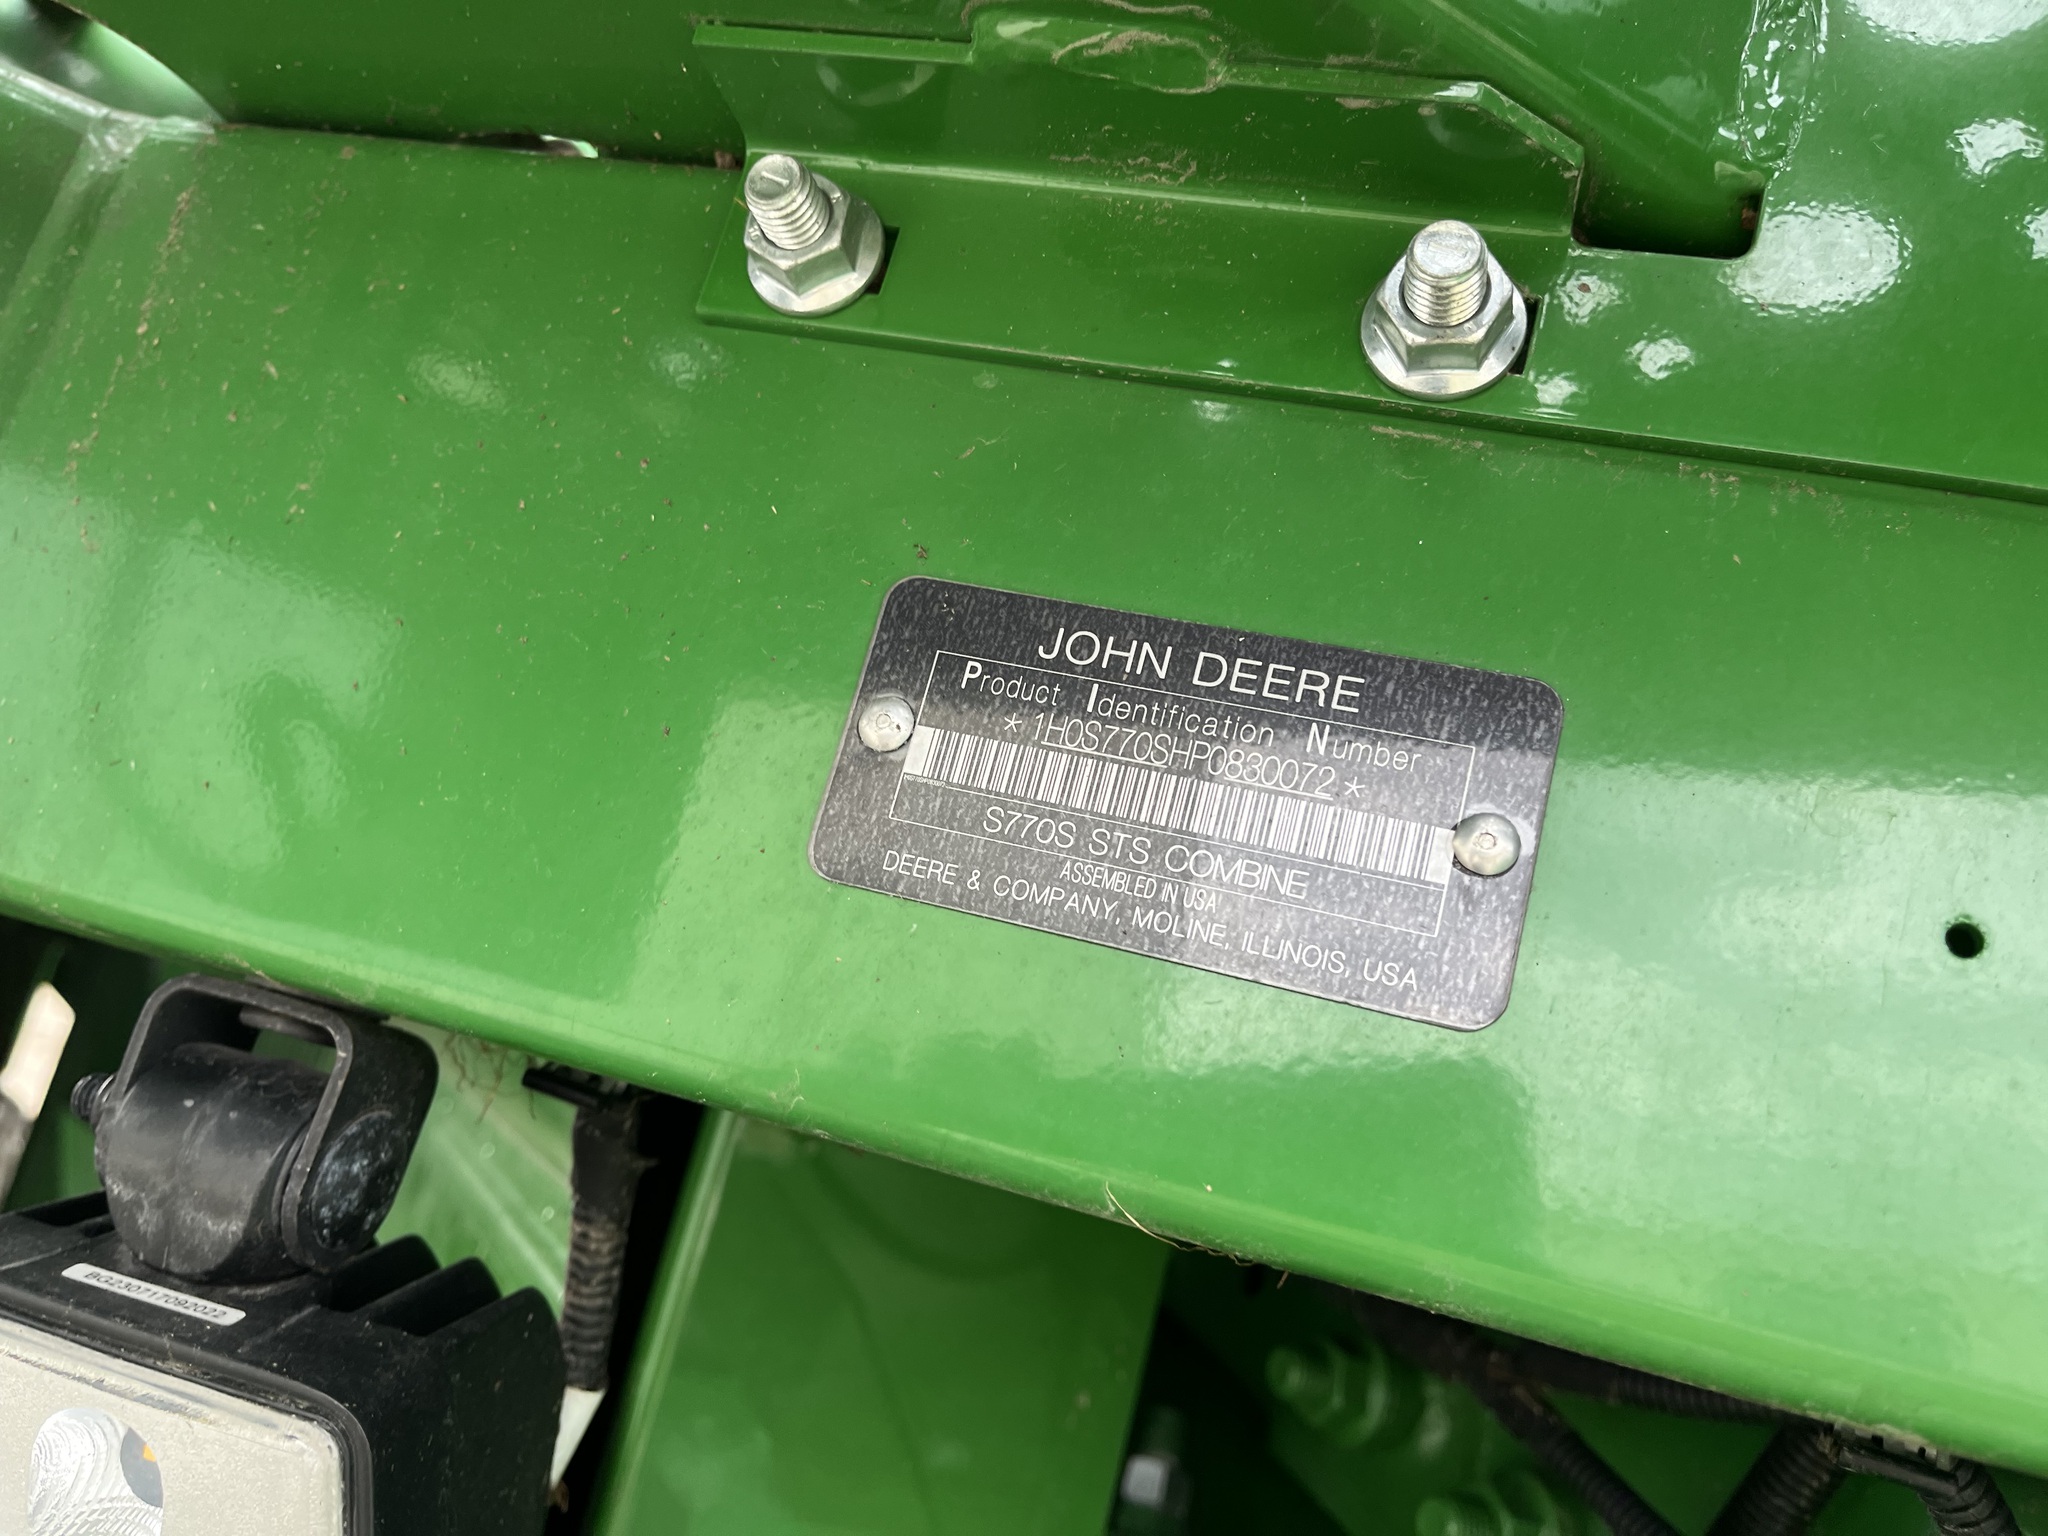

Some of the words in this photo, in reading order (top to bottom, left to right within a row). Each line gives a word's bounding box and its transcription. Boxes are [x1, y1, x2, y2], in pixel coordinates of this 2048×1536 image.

[961, 660, 1061, 706] Product
[1087, 683, 1274, 747] Identification
[1306, 722, 1421, 772] Number
[1038, 627, 1173, 679] JOHN
[1192, 651, 1365, 713] DEERE
[983, 806, 1076, 849] S770S
[1088, 828, 1152, 864] STS
[1165, 845, 1310, 900] COMBINE
[1059, 861, 1157, 899] ASSEMBLED
[1161, 881, 1179, 904] IN
[1184, 886, 1216, 913] USA
[882, 850, 958, 885] DEERE
[967, 869, 981, 891] &
[993, 875, 1121, 924] COMPANY,
[1132, 906, 1229, 949] MOLINE,
[1241, 931, 1349, 977] ILLINOIS,
[1363, 958, 1418, 991] USA
